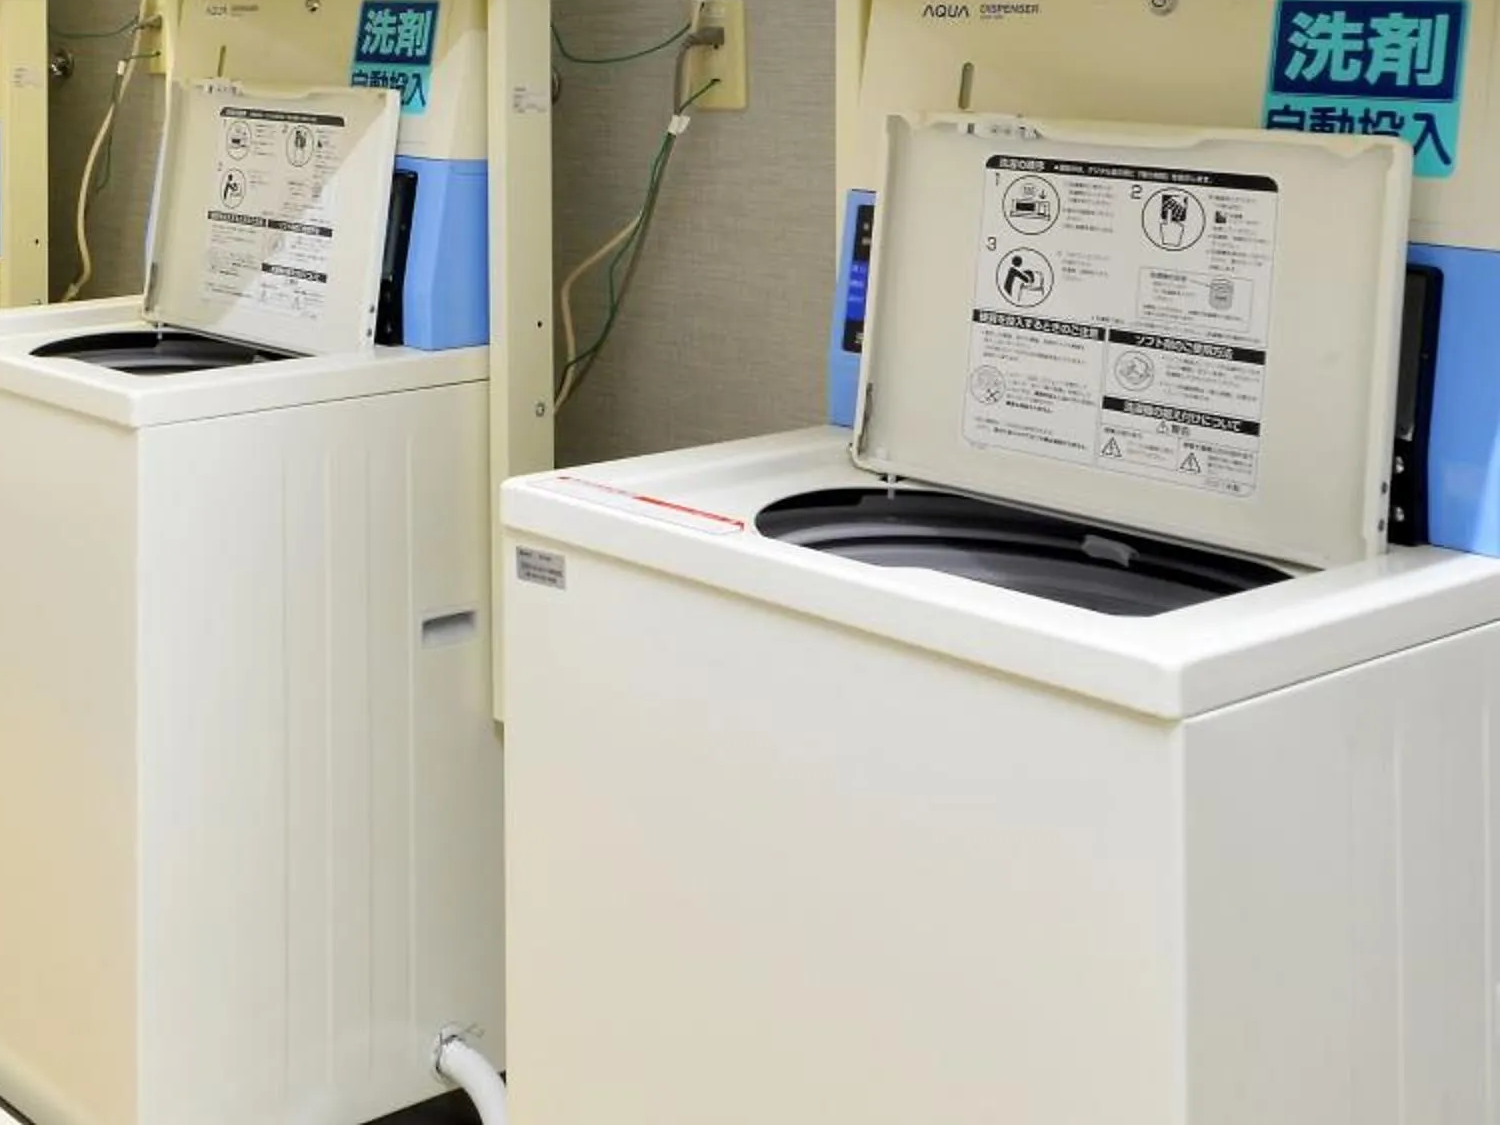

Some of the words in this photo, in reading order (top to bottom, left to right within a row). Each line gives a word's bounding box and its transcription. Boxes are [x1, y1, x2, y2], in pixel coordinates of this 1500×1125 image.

[922, 4, 970, 17] AQUA
[361, 9, 433, 57] 洗剤
[1284, 11, 1449, 86] 洗剤
[1130, 184, 1143, 200] 2
[986, 236, 997, 251] 3
